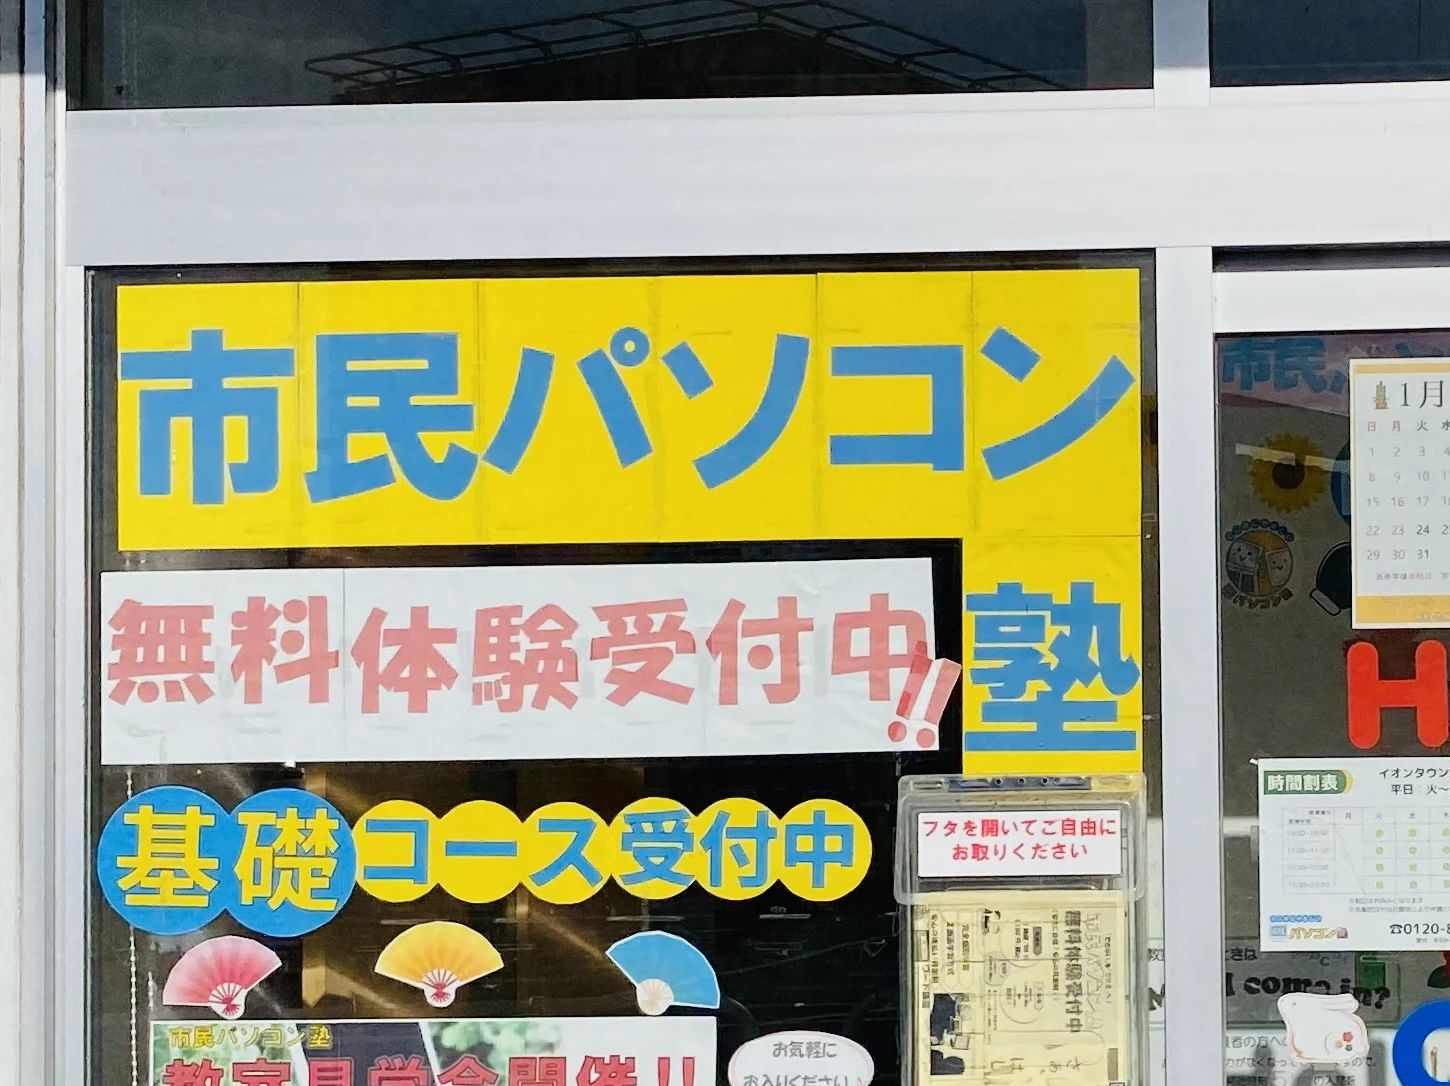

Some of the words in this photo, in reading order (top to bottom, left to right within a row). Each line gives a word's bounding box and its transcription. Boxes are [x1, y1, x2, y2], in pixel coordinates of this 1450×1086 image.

[1400, 380, 1444, 408] 1月
[120, 327, 1135, 504] 市民パソコン
[1416, 419, 1429, 431] 火
[1416, 525, 1431, 535] 24
[1416, 549, 1430, 559] 31
[107, 591, 961, 748] 無料体験受付中!!
[966, 582, 1141, 752] 塾
[1267, 774, 1339, 792] 時間割表
[923, 817, 1117, 838] フタを開いてご自由に
[116, 803, 866, 912] 基礎コース受付中
[952, 843, 1088, 861] お取りください
[169, 1024, 332, 1049] 市民パソコン塾
[772, 1041, 838, 1058] お気軽に
